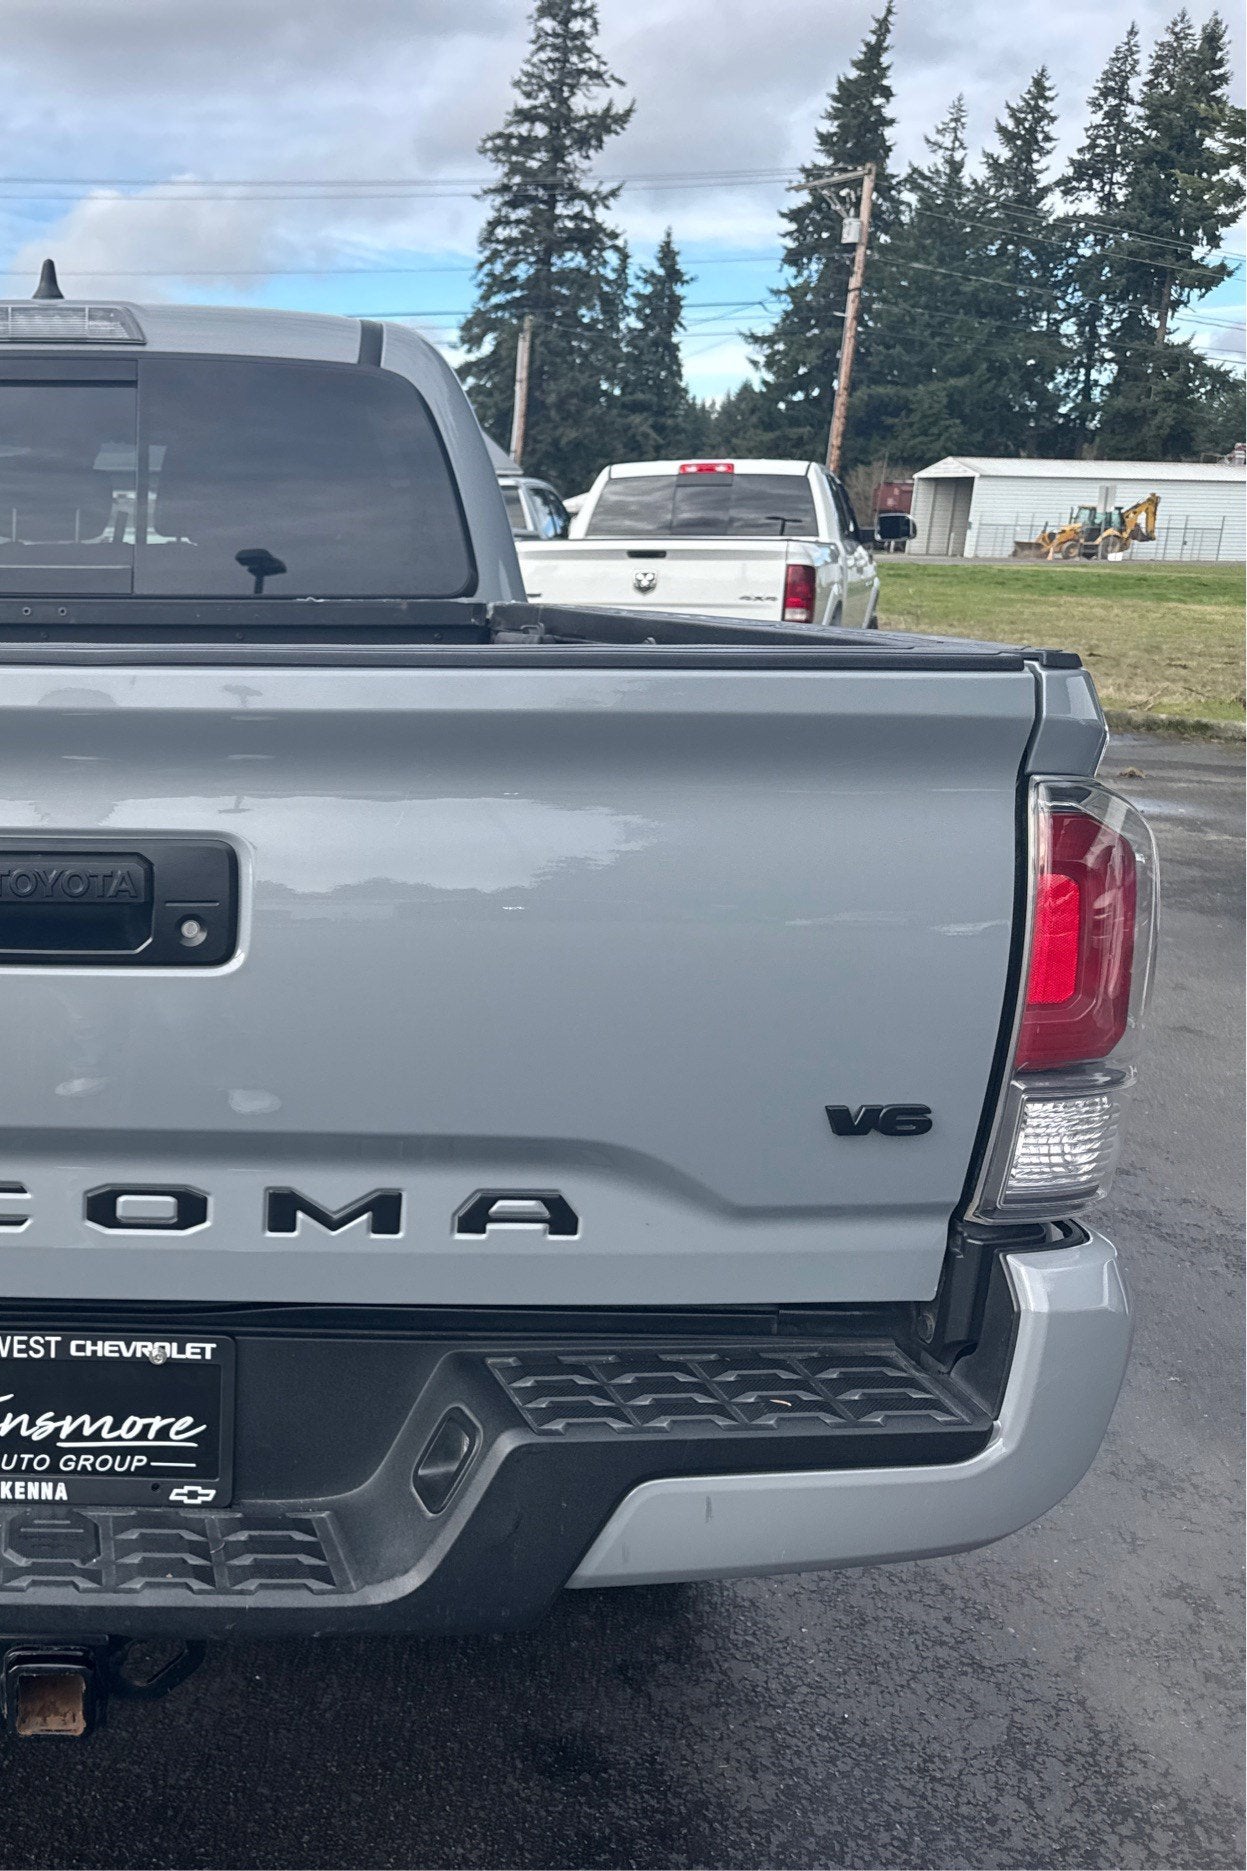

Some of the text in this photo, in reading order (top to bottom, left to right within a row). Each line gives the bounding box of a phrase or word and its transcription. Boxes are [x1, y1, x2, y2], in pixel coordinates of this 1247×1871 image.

[825, 1103, 933, 1137] V6
[70, 1340, 217, 1361] CHEVROLET
[59, 1454, 148, 1472] GROUP
